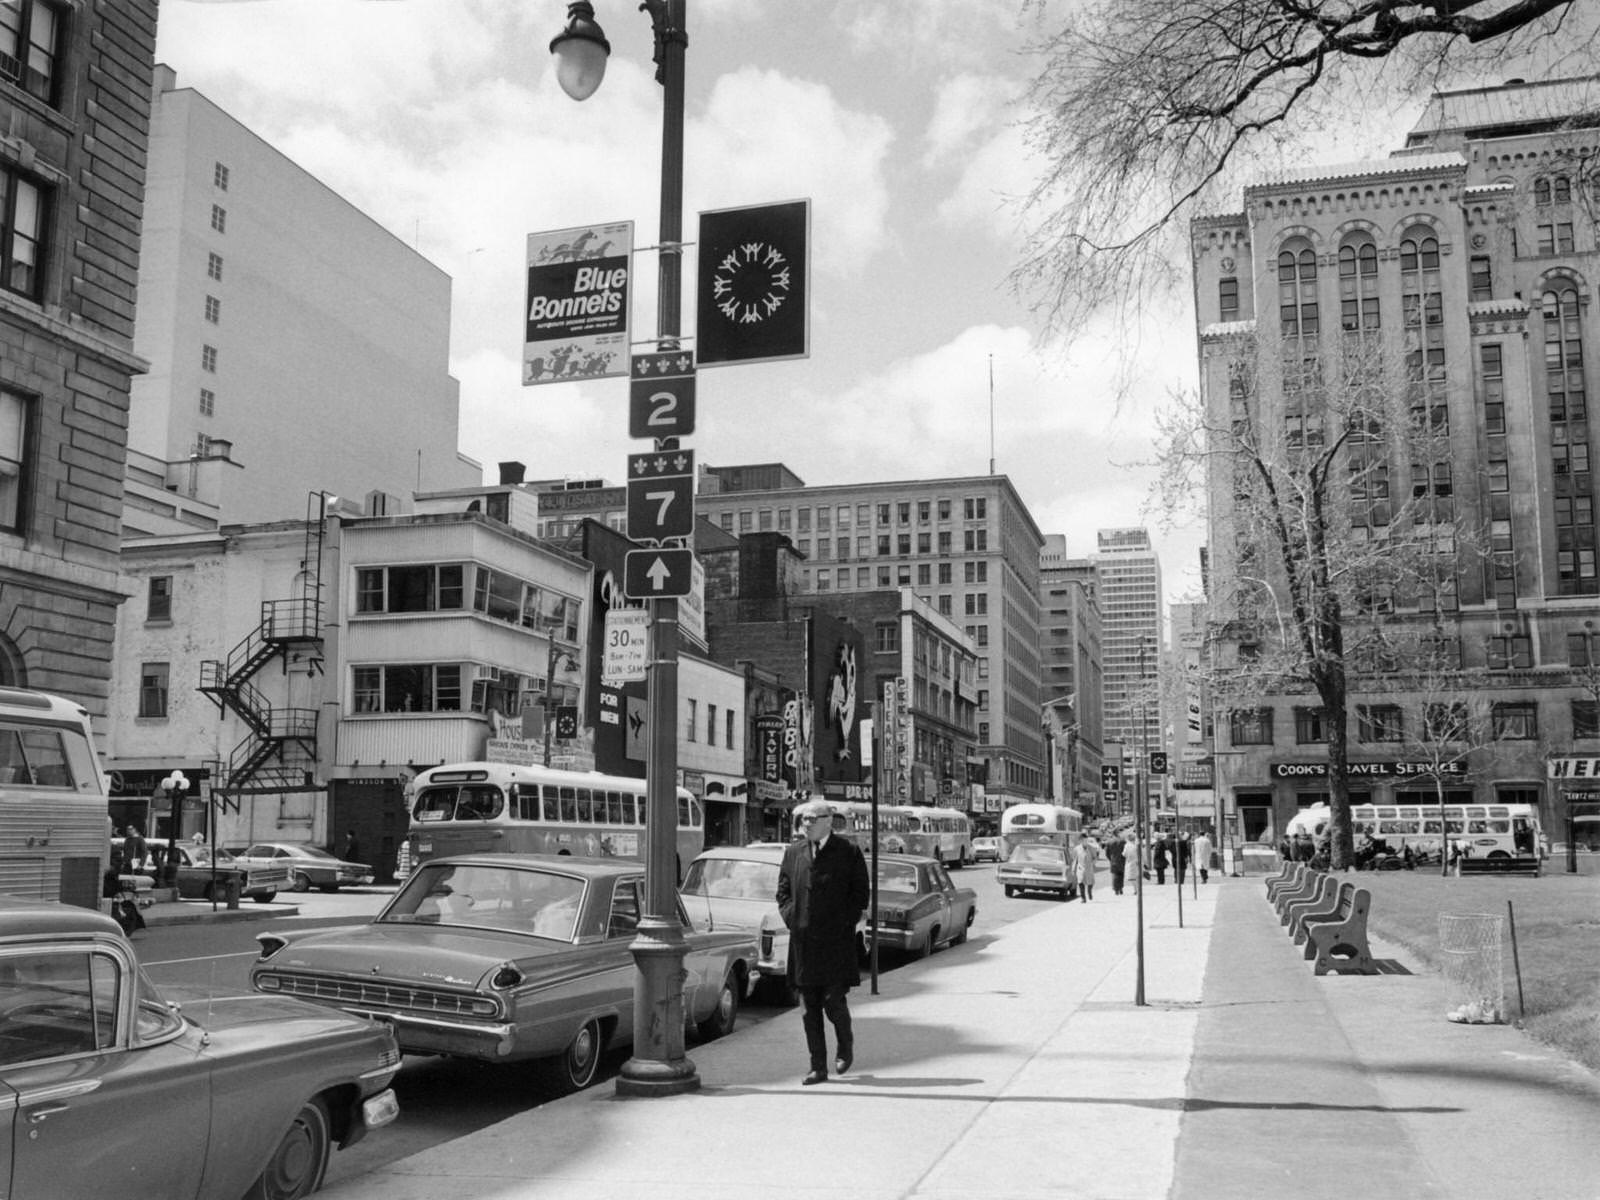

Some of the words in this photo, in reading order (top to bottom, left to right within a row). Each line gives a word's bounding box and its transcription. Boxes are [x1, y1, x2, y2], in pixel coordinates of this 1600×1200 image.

[574, 267, 627, 293] Blue
[529, 289, 622, 320] Bonnets
[647, 391, 677, 426] 2
[645, 490, 676, 526] 7
[609, 629, 630, 647] 30
[631, 638, 645, 646] MIN
[600, 692, 619, 707] FOR
[766, 730, 777, 780] TAVERN
[1277, 763, 1326, 777] COOK'S
